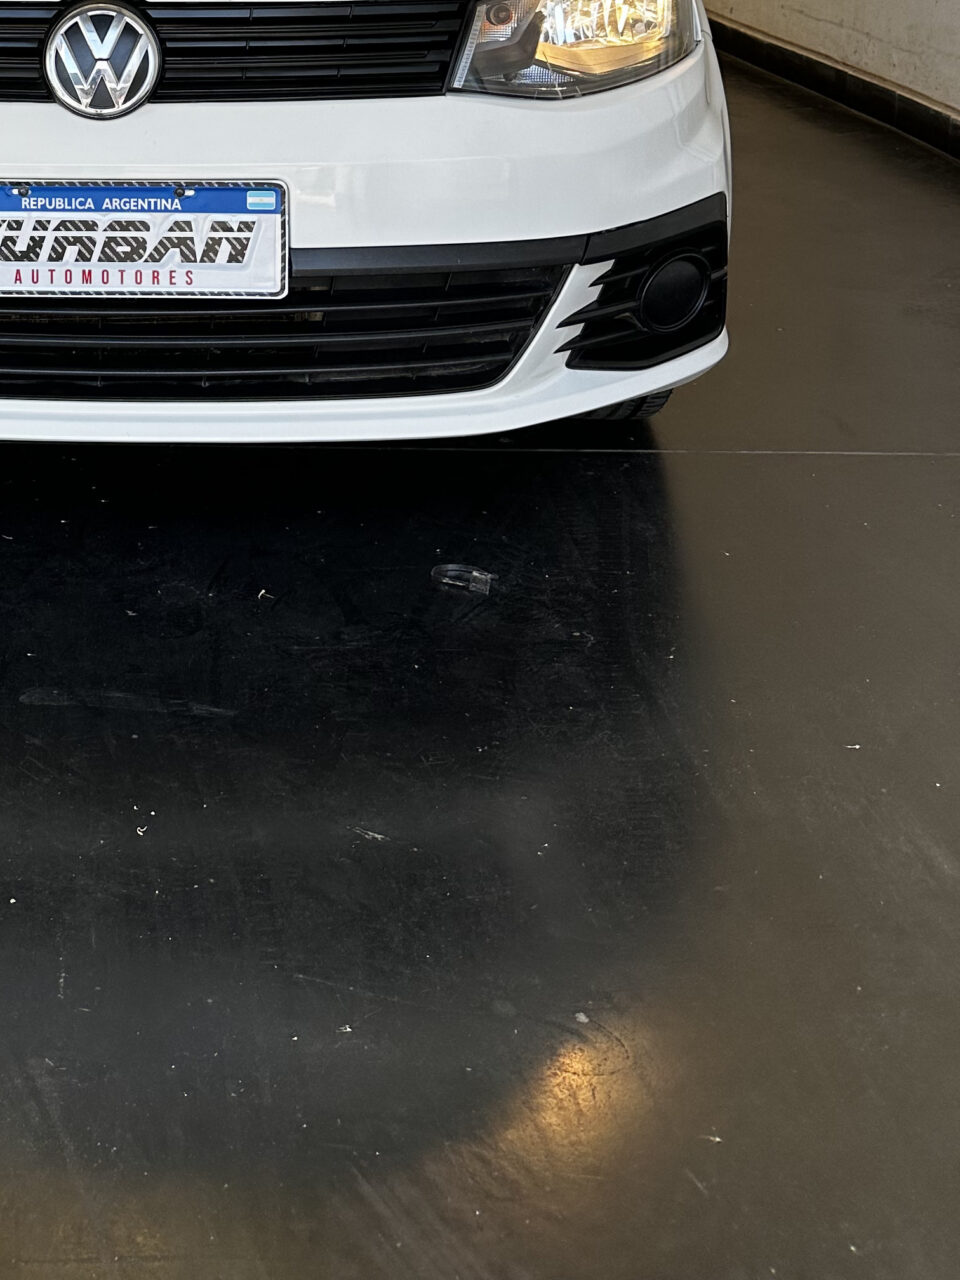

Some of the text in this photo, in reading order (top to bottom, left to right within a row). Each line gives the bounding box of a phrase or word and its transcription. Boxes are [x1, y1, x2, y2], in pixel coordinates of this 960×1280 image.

[21, 197, 182, 211] REPUBLICA ARGENTINA
[14, 269, 194, 286] AUTOMOTORES
